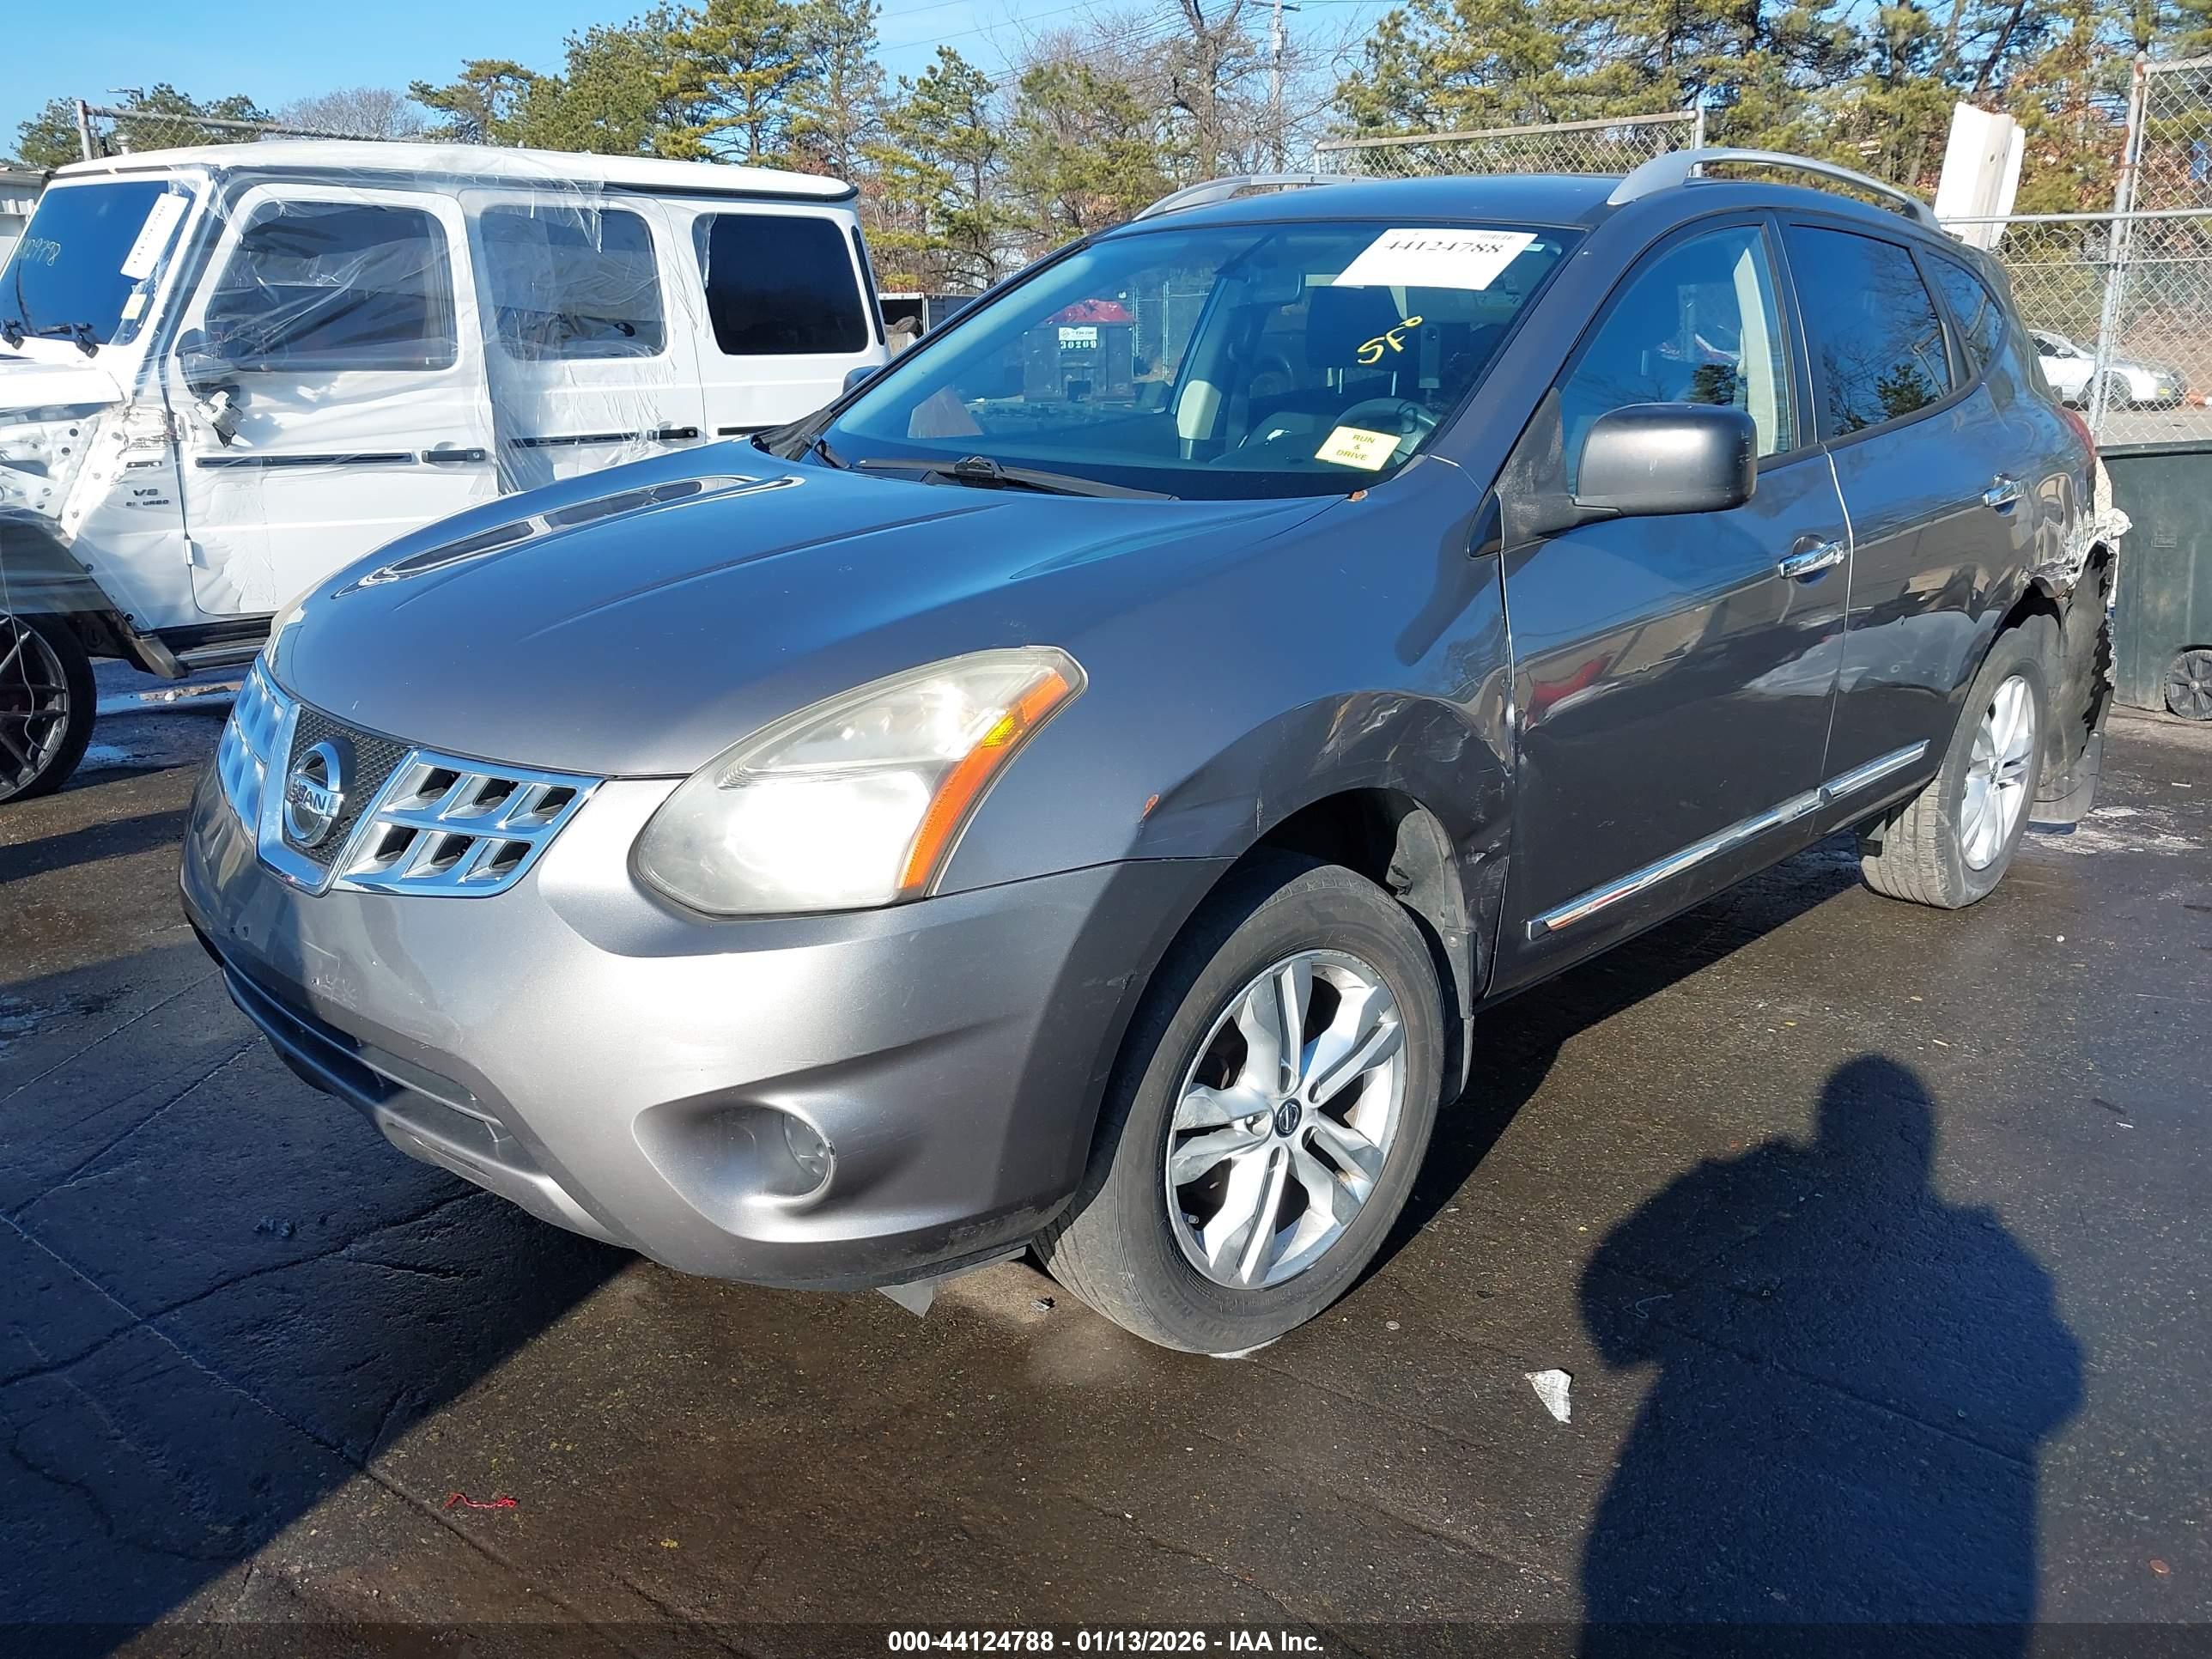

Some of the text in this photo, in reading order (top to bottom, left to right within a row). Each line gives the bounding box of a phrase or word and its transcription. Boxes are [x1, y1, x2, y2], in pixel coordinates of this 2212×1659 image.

[1384, 240, 1504, 253] 44124788
[1352, 434, 1376, 443] RUN
[1336, 450, 1369, 461] DRIVE
